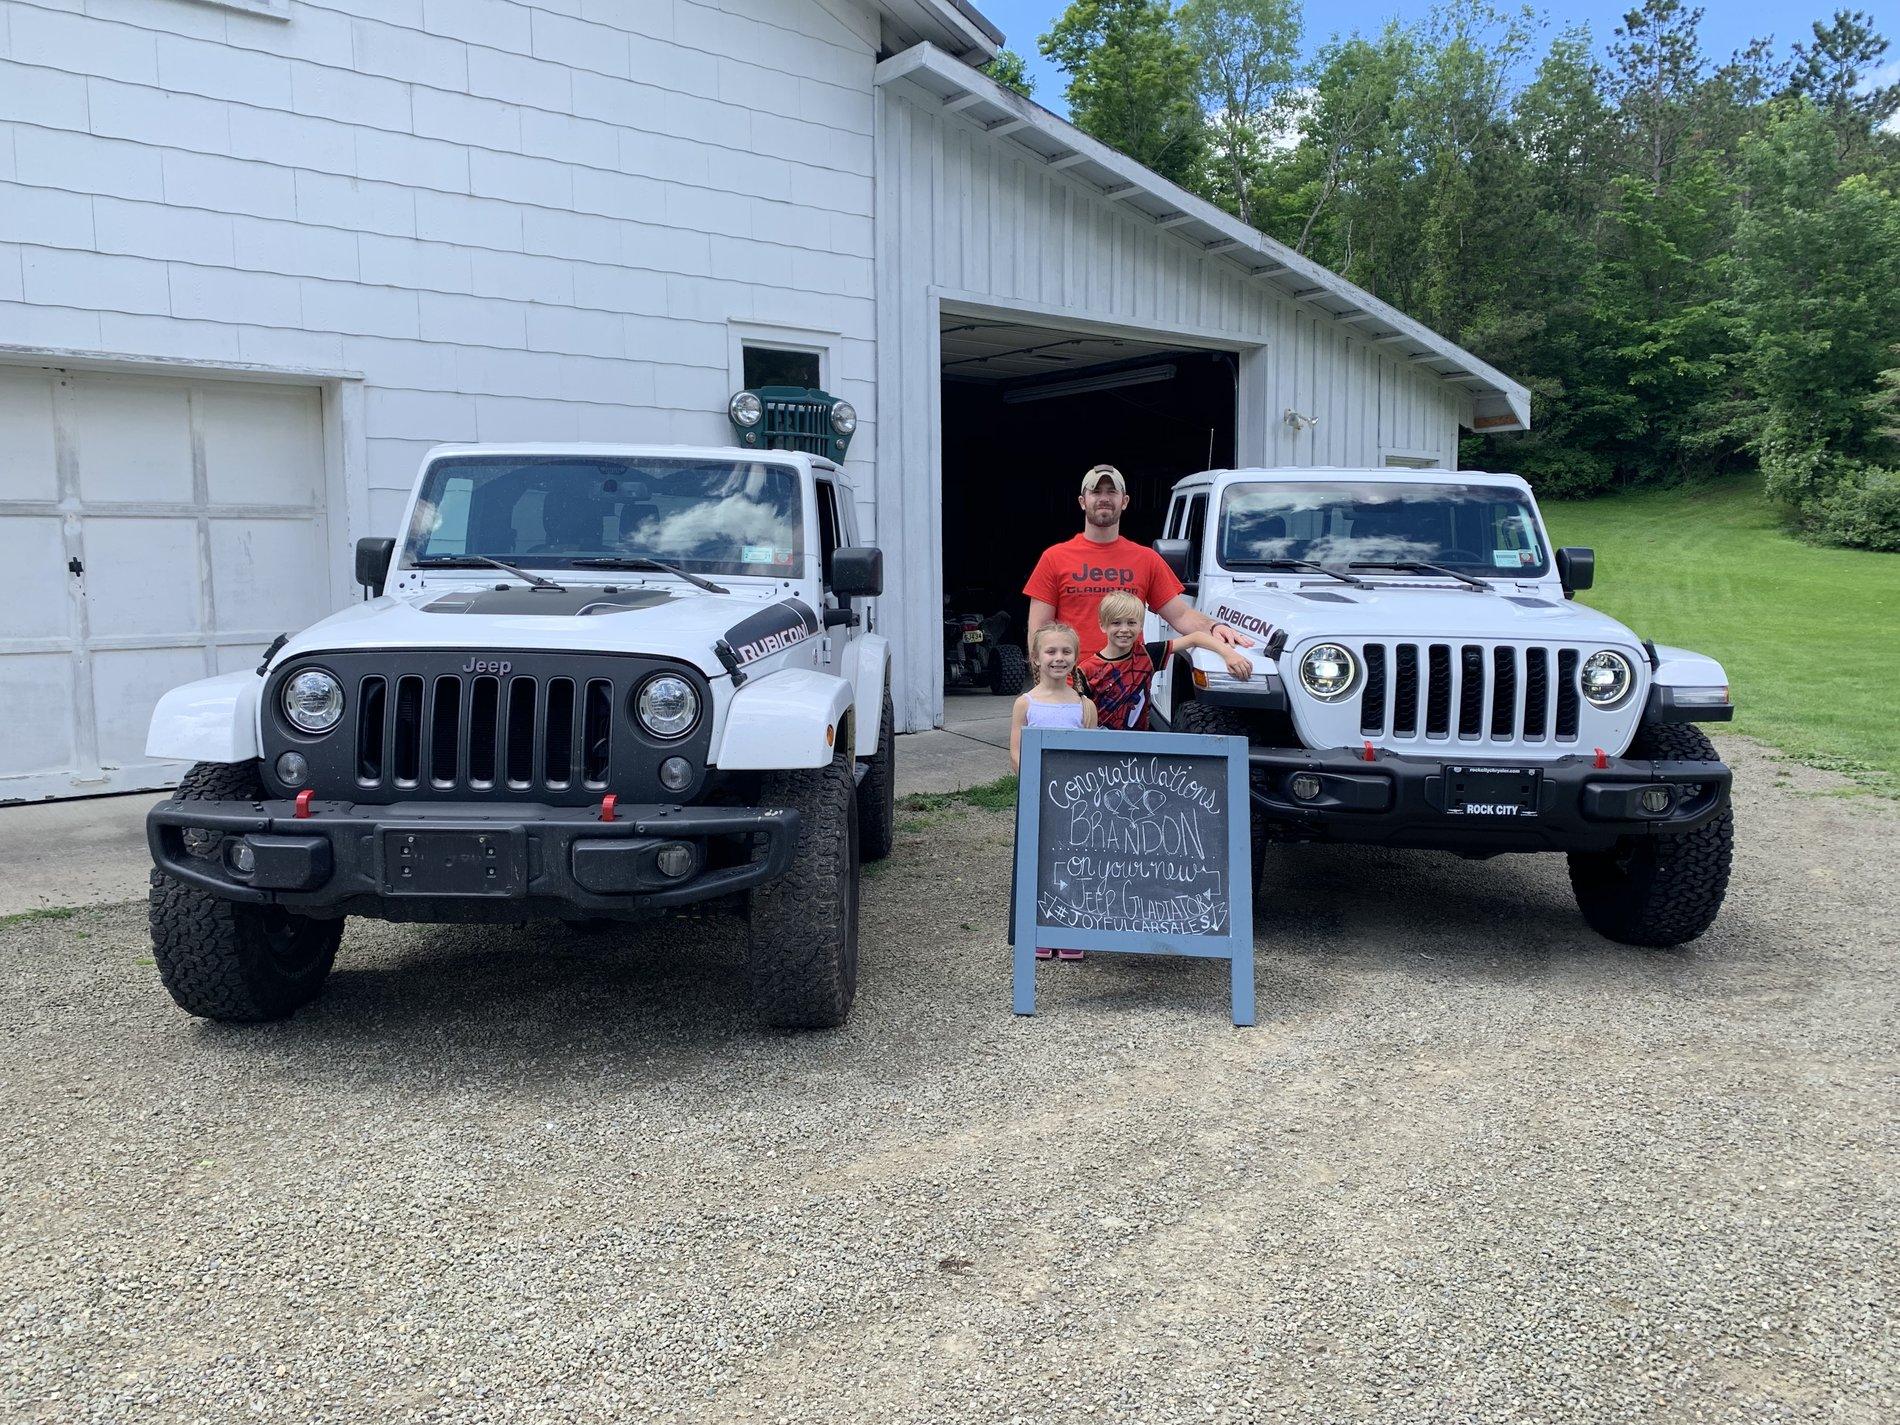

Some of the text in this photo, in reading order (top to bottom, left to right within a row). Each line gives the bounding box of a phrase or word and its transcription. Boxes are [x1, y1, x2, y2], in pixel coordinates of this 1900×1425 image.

[1072, 563, 1134, 585] Jeep
[1216, 605, 1274, 637] RUBICON
[737, 624, 809, 663] RUBICON
[462, 657, 511, 676] Jeep
[1048, 757, 1220, 814] Congratulations
[1466, 804, 1494, 815] ROCK
[1496, 805, 1519, 816] CITY
[1069, 800, 1205, 860] BRANDON
[1066, 856, 1206, 895] on your new
[1055, 906, 1212, 935] #JOYFULCARSALES
